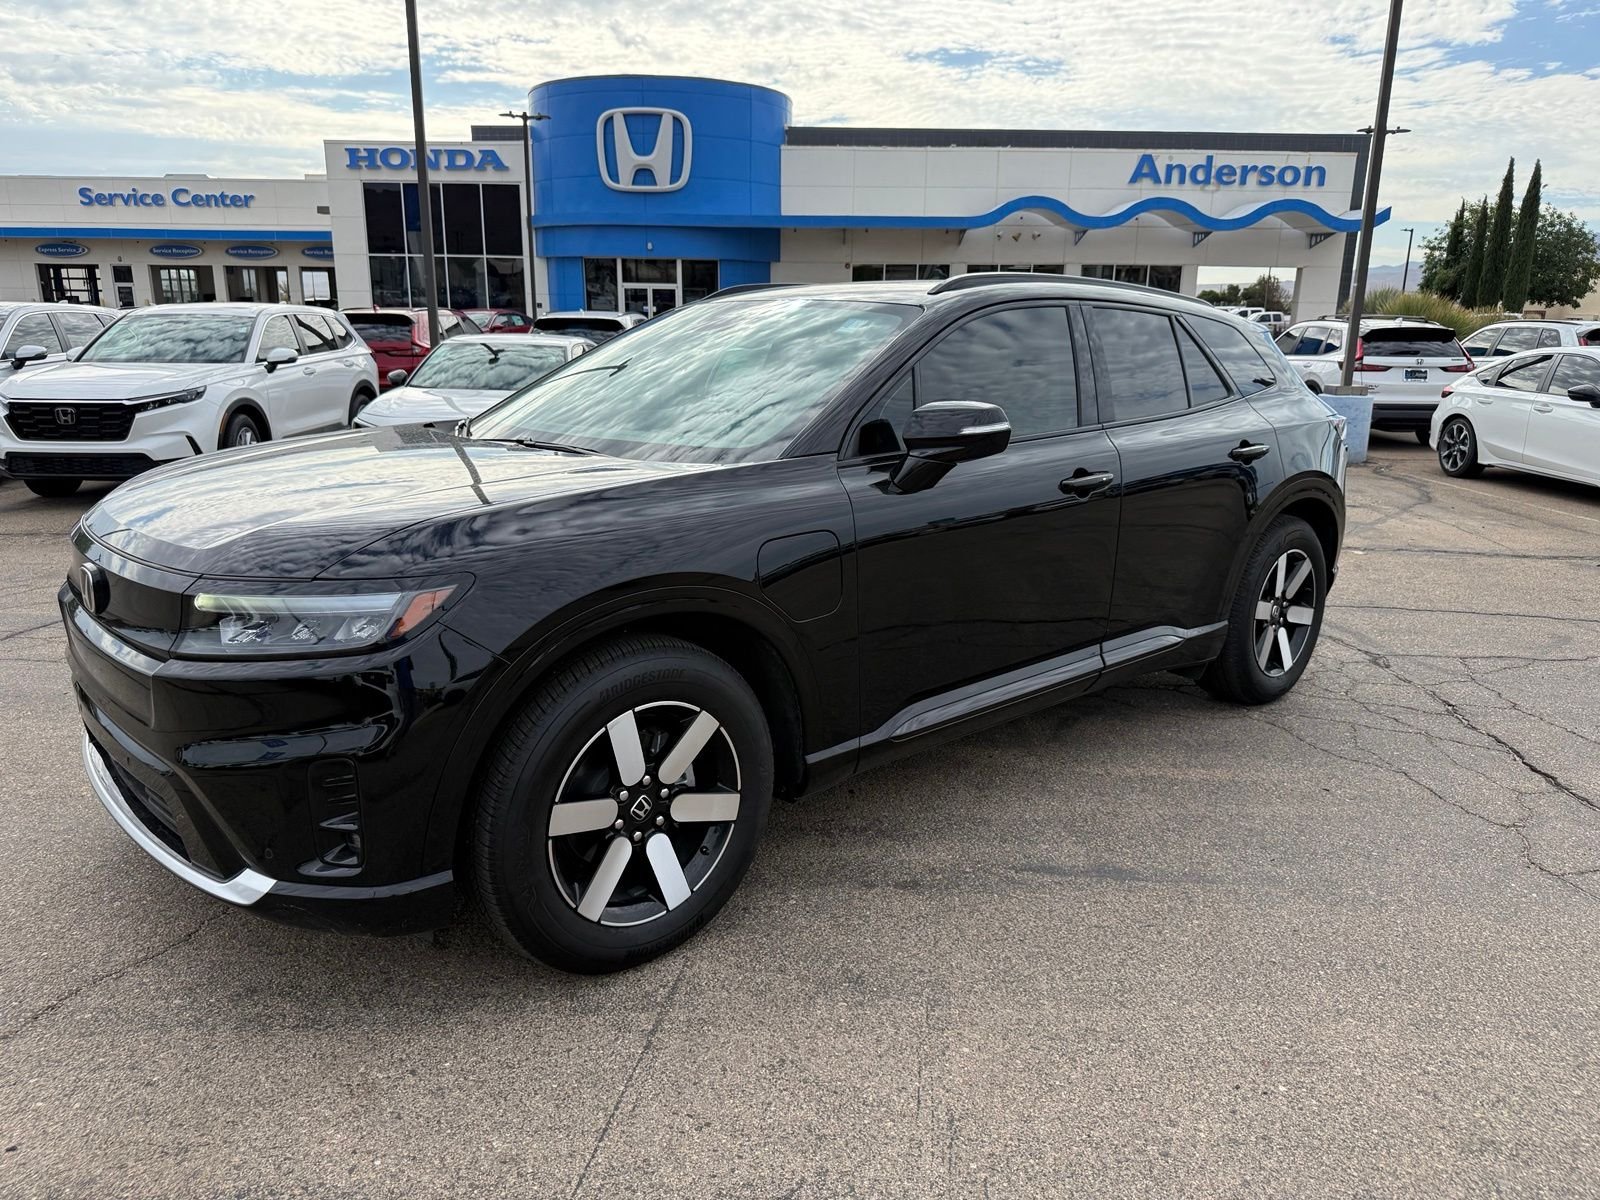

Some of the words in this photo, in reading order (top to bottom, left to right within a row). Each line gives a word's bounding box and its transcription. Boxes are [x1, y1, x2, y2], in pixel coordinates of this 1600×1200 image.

[344, 147, 509, 171] HONDA
[1128, 153, 1327, 187] Anderson
[78, 187, 165, 207] Service
[171, 188, 255, 208] Center
[600, 668, 688, 703] BRIDGESTONE
